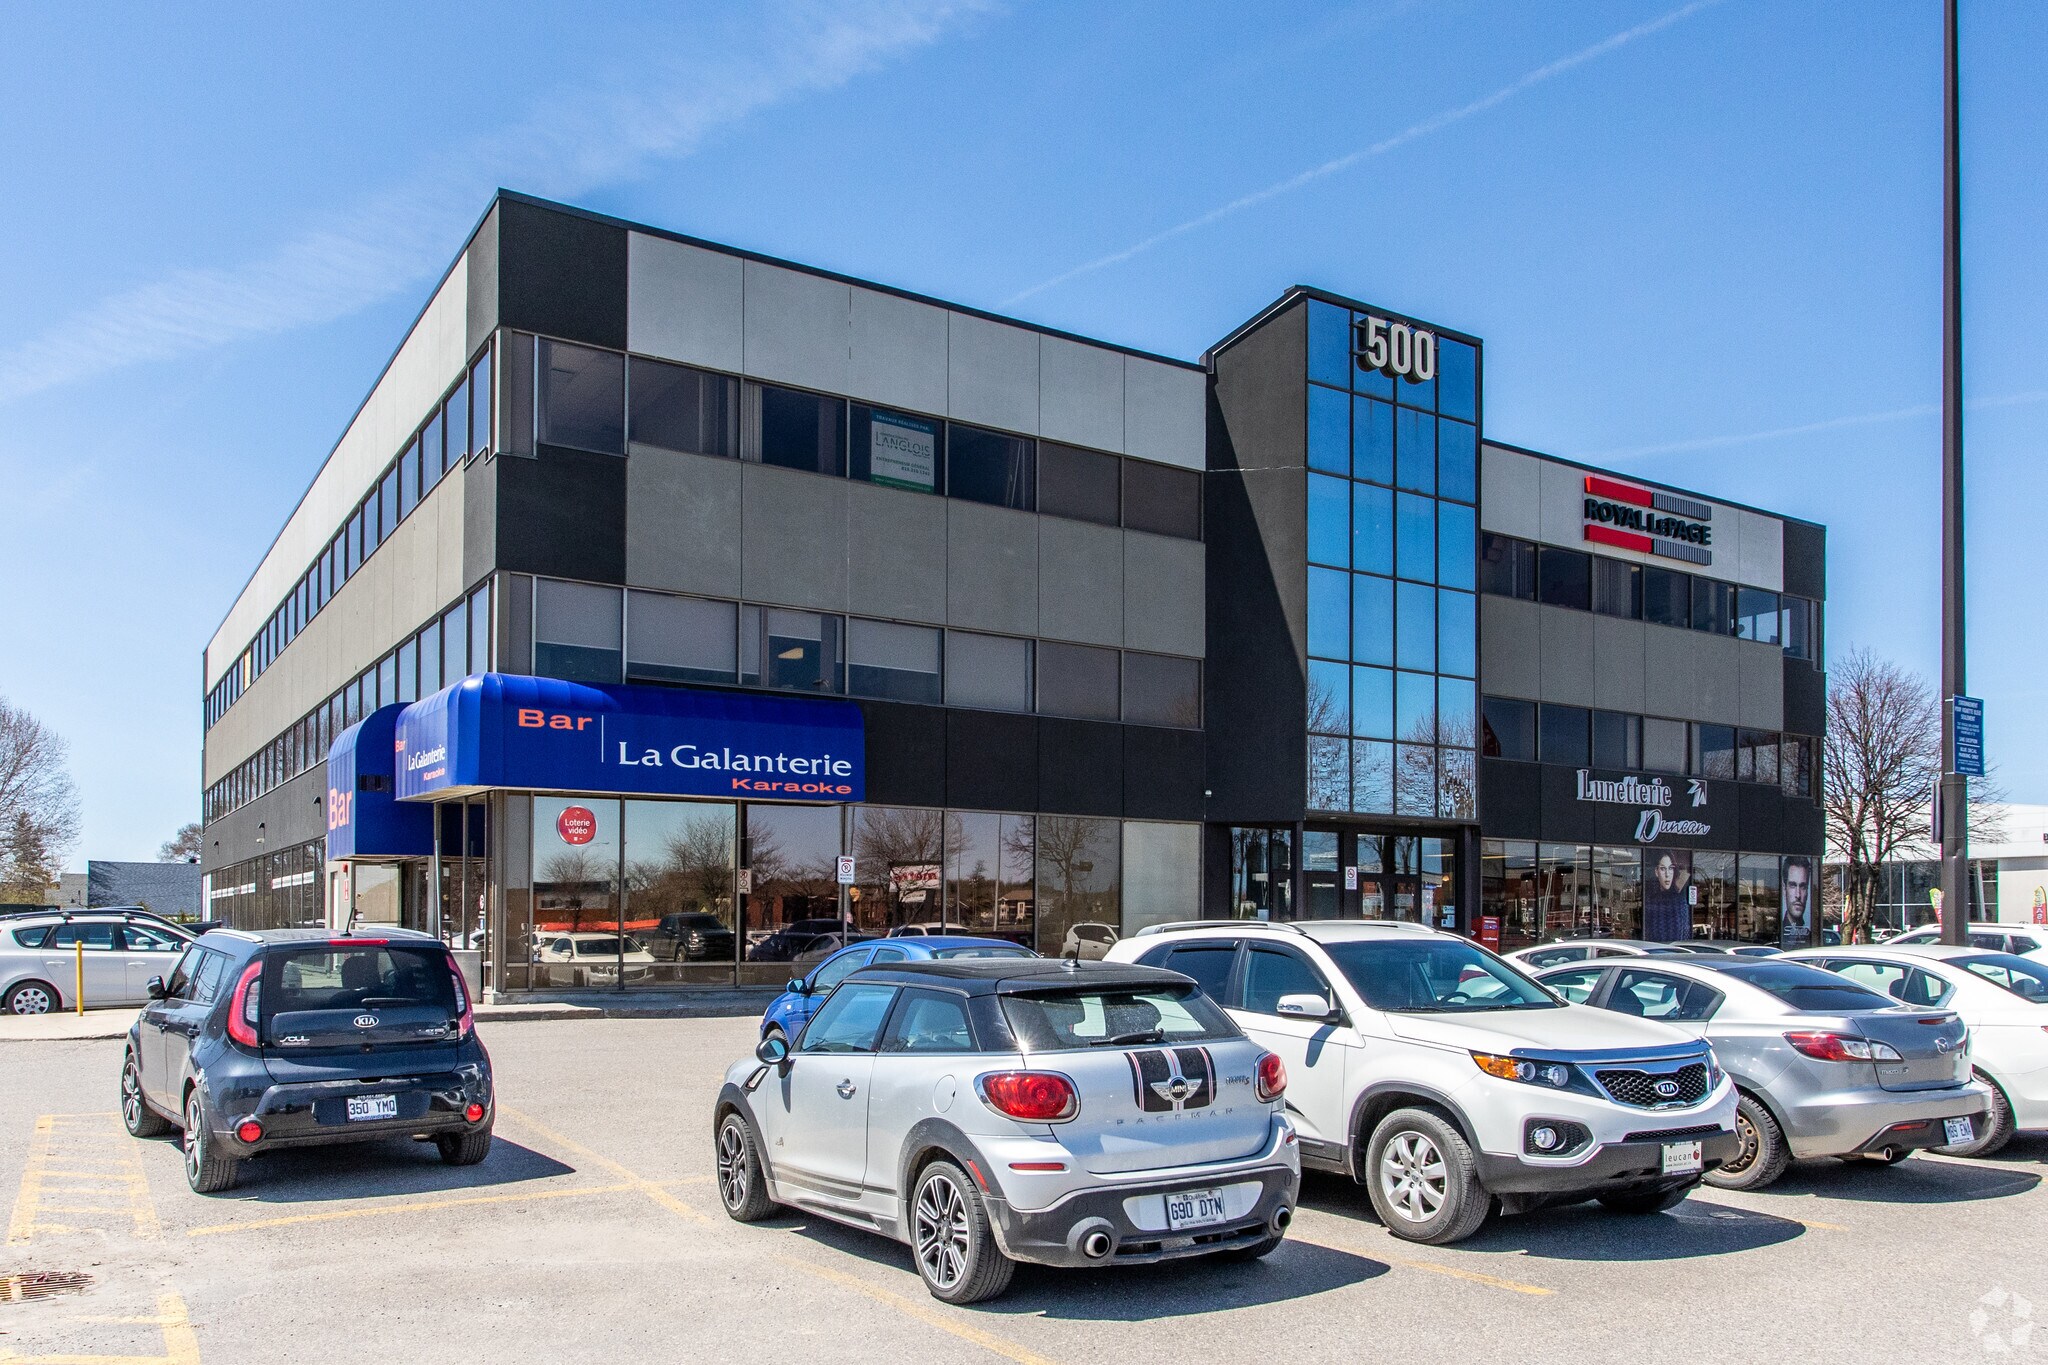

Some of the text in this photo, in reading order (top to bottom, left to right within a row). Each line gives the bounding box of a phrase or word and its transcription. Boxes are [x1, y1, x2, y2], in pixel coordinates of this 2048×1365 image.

[1365, 316, 1435, 381] 500
[875, 431, 931, 457] LANGLOIS
[1584, 498, 1647, 532] ROYAL
[518, 708, 593, 731] Bar
[395, 740, 406, 752] Bar
[408, 745, 446, 771] La Galanterie
[618, 741, 852, 777] La Galanterie
[423, 767, 445, 781] Karaoke
[731, 778, 852, 794] Karaoke
[1576, 769, 1672, 807] Lunetterie
[329, 787, 353, 831] Bar
[564, 818, 591, 827] Loterie
[1634, 808, 1711, 843] Duncan
[357, 1017, 374, 1025] KIA
[1171, 1083, 1187, 1093] MINI
[1660, 1084, 1675, 1093] KIA
[349, 1100, 396, 1115] 350 YMQ
[1665, 1152, 1692, 1163] leucan
[1170, 1197, 1223, 1221] G90 DTN
